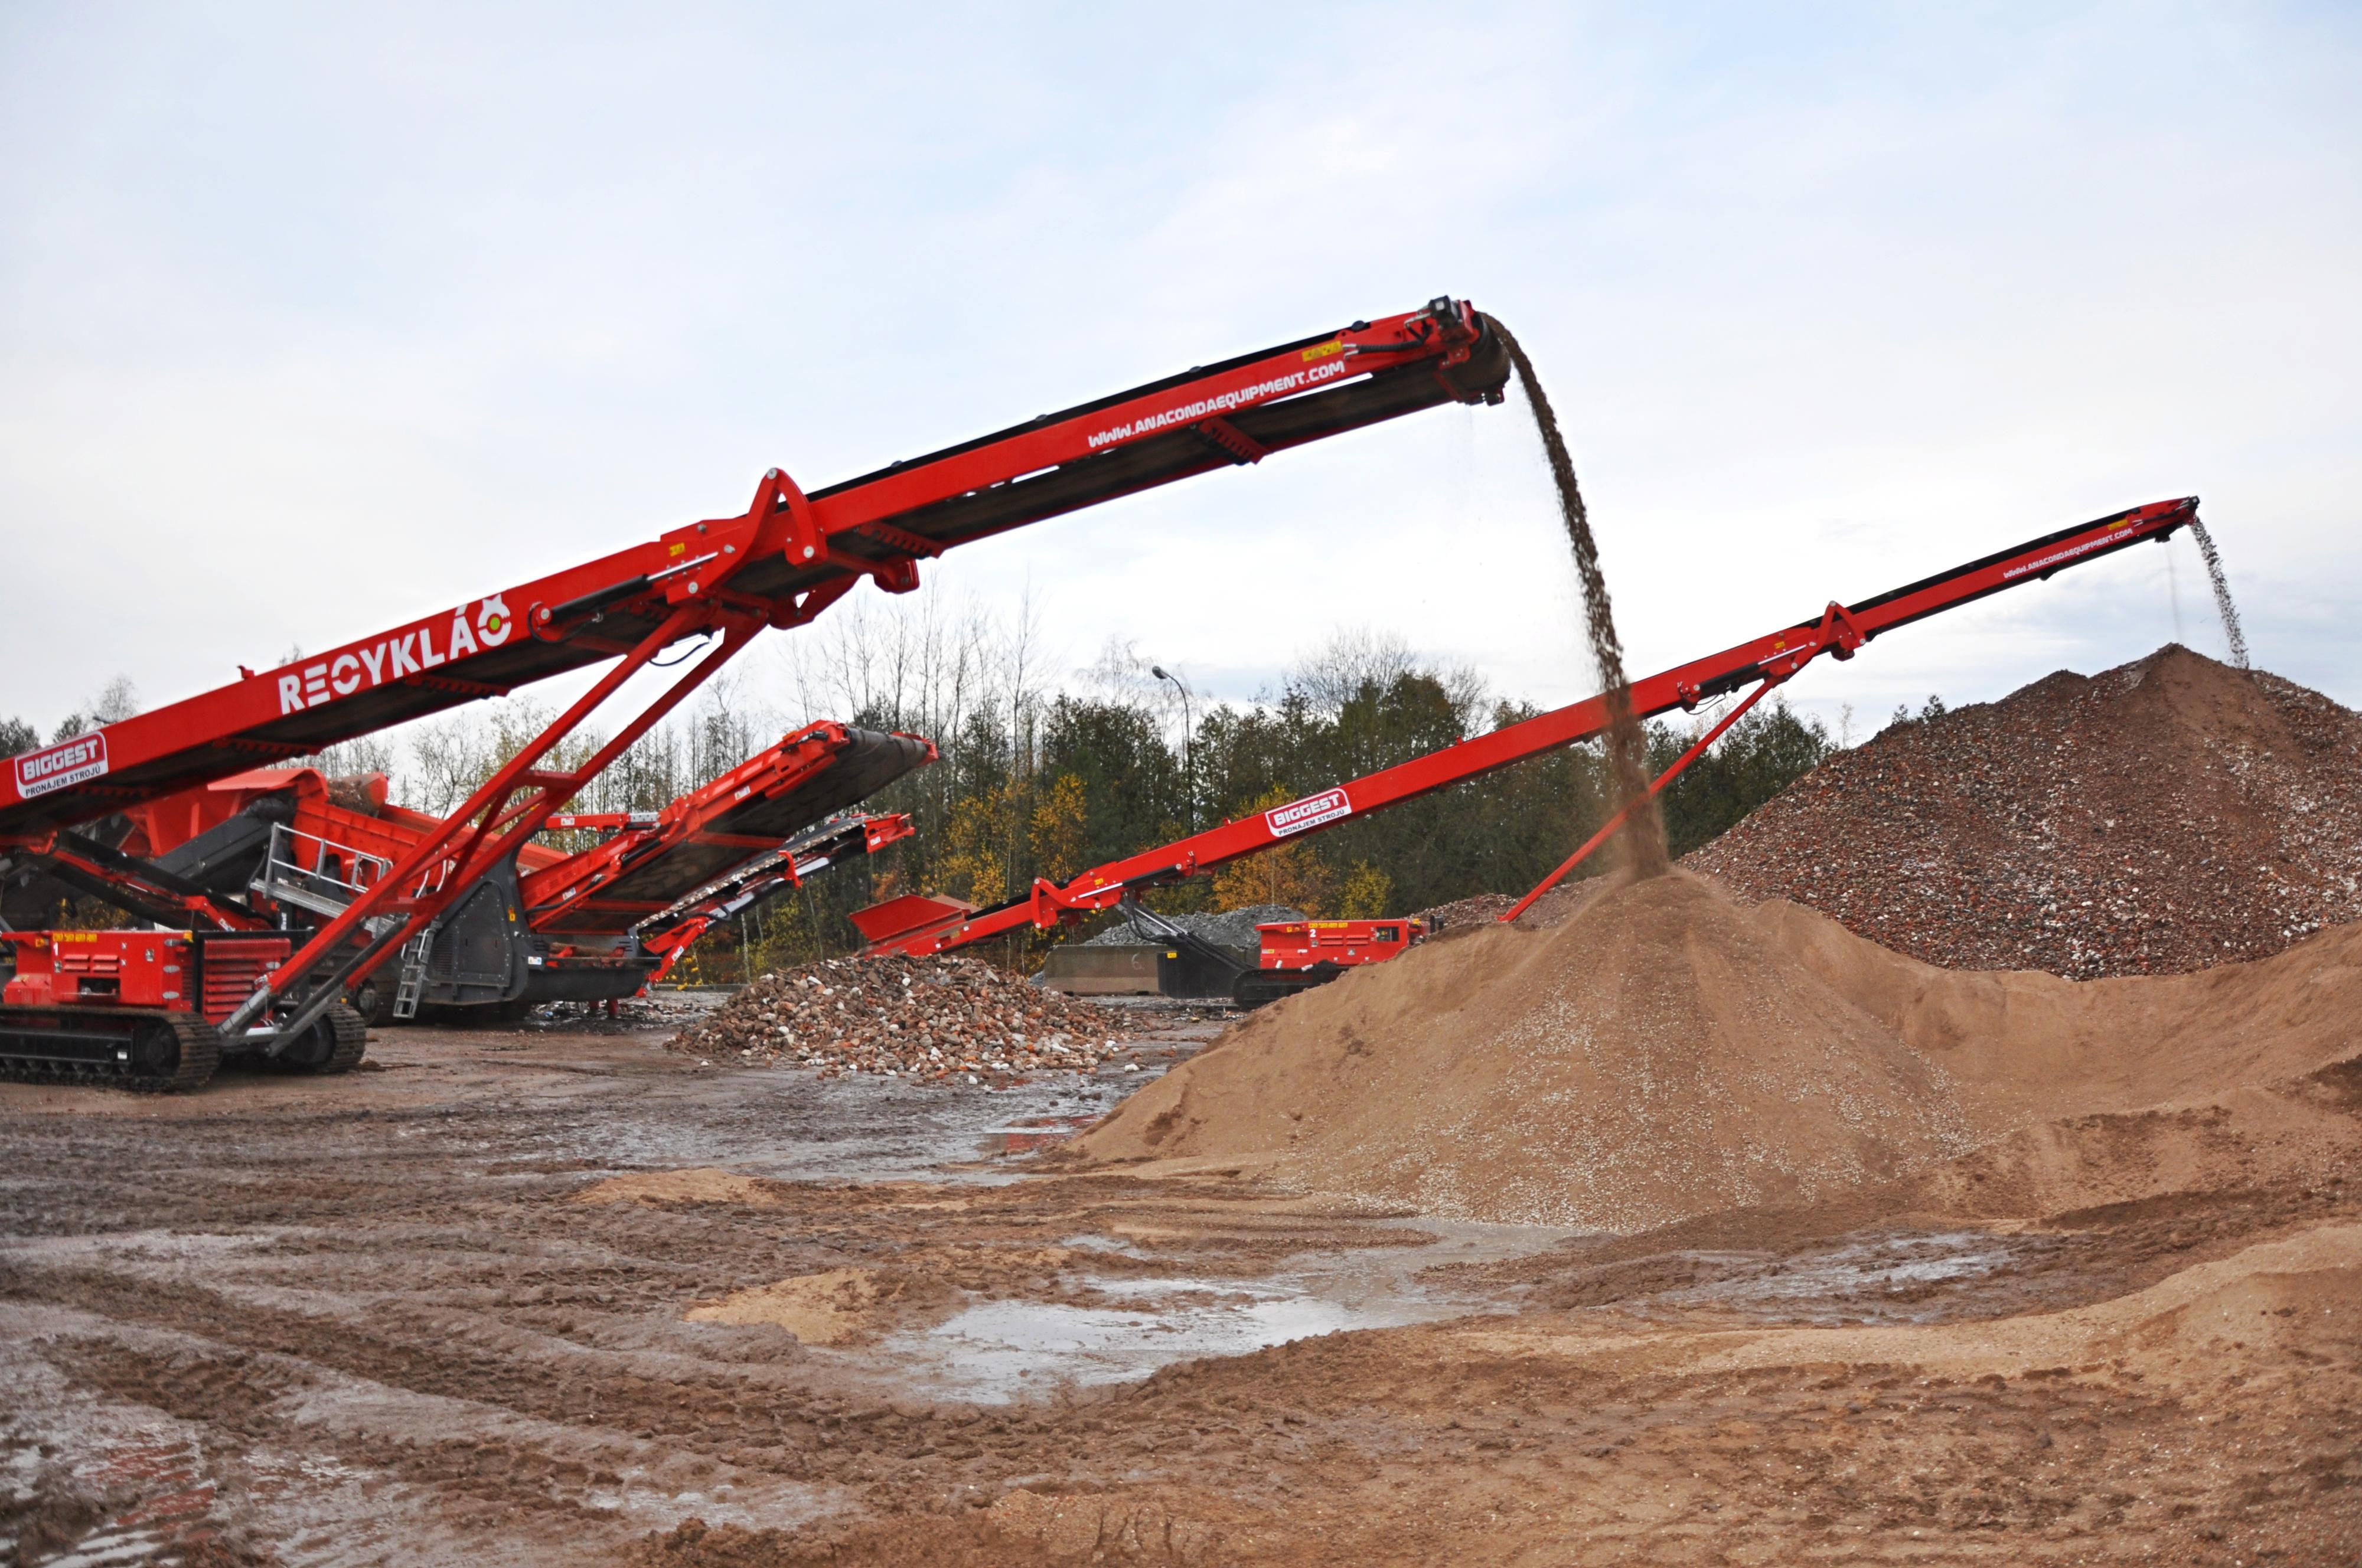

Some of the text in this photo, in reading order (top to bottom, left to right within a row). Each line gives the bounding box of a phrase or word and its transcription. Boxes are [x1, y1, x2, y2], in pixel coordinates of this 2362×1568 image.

[1088, 360, 1345, 448] WWW.ANACONDAEQUIPMENT.COM
[2003, 528, 2133, 579] WWW.ANACONDAEQUIPMENT.COM
[23, 739, 97, 781] BIGGEST
[25, 764, 100, 797] PRONÁJEM STROJŮ
[1273, 793, 1339, 826] BIGGEST
[1278, 819, 1316, 835] PRONÁJEM
[53, 942, 58, 956] 1
[1309, 929, 1316, 937] 2
